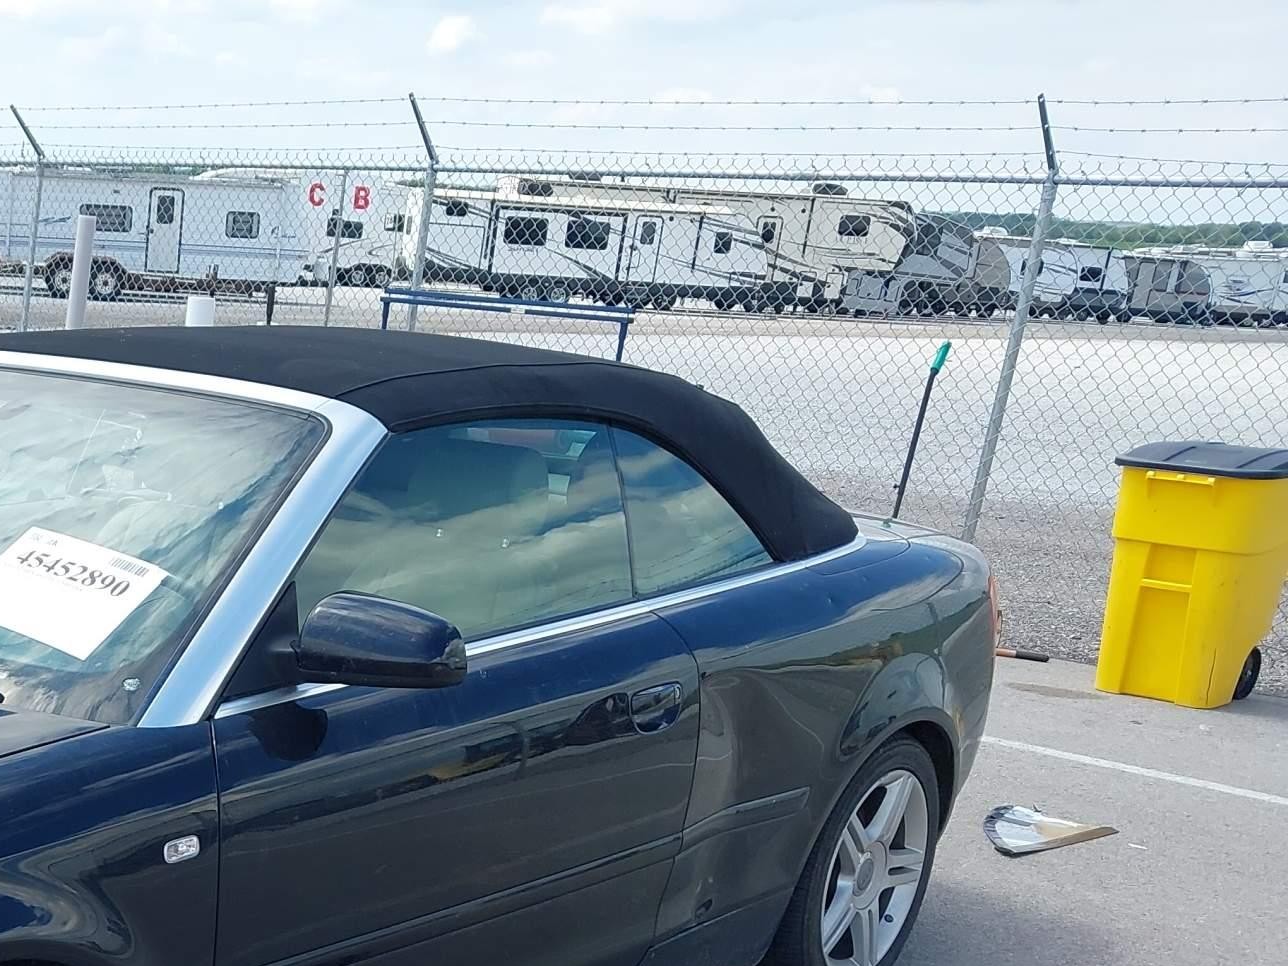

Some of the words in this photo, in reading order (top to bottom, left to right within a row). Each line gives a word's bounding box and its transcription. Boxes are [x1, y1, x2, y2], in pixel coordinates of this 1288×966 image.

[309, 182, 326, 207] C
[353, 185, 371, 210] B
[16, 549, 131, 597] 45452890
